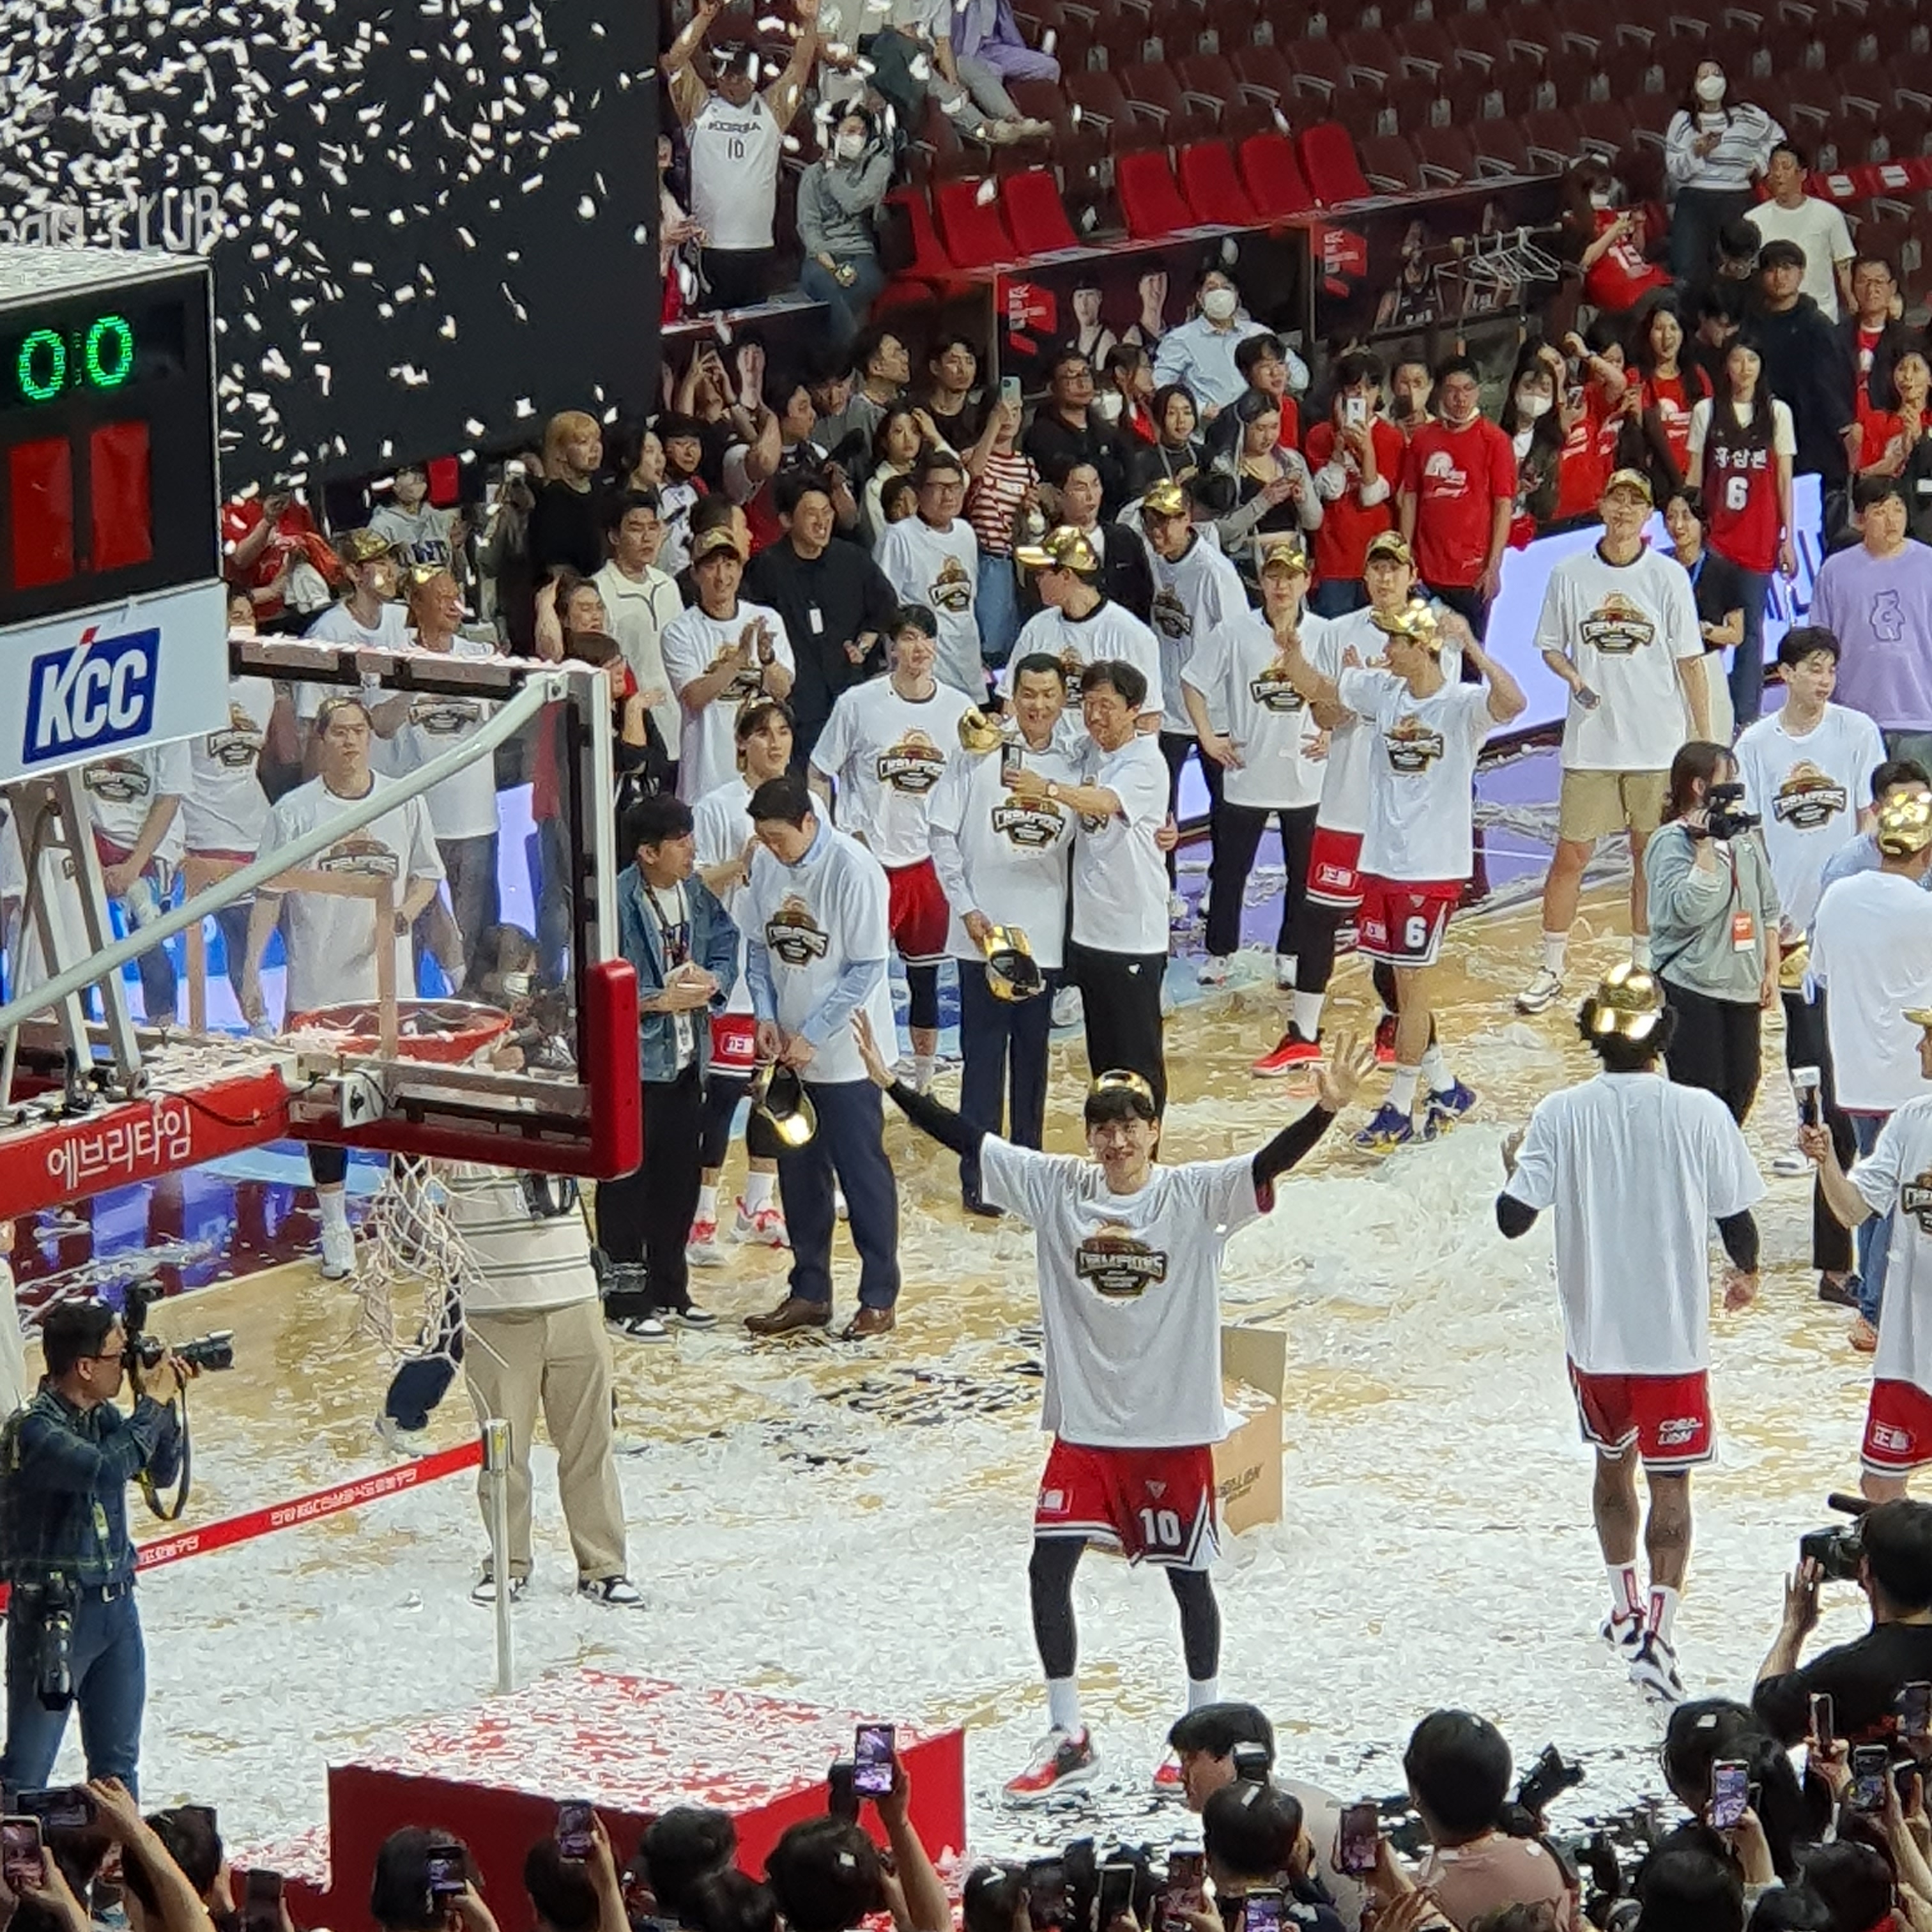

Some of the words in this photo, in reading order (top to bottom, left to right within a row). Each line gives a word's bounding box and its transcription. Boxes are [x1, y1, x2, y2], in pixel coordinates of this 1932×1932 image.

[728, 137, 744, 160] 10
[1727, 476, 1748, 510] 6
[36, 625, 148, 747] KCC
[1406, 916, 1427, 948] 6
[47, 1105, 191, 1190] 에브리타임
[1139, 1507, 1181, 1546] 10
